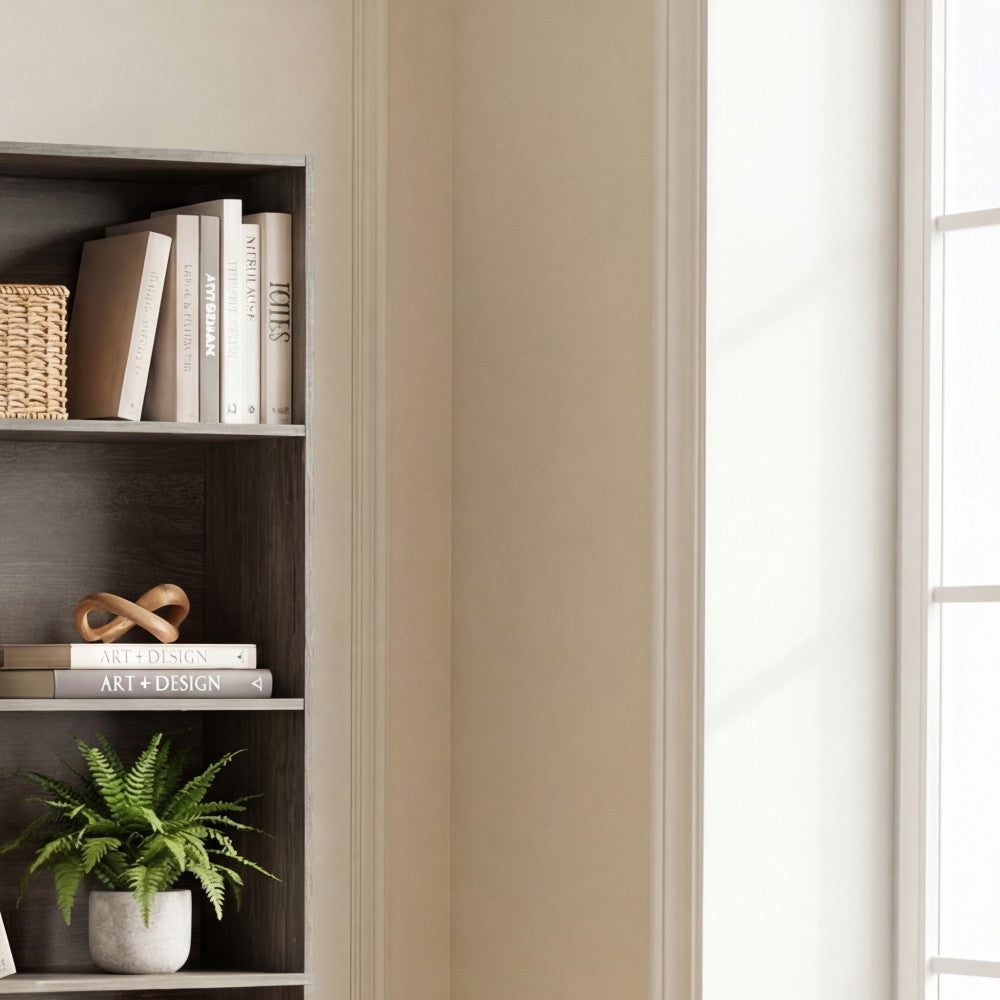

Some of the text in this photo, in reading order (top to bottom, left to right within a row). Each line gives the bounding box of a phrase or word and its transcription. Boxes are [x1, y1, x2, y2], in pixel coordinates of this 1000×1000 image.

[100, 649, 208, 664] ART + DESIGN
[100, 675, 221, 692] ART + DESIGN
